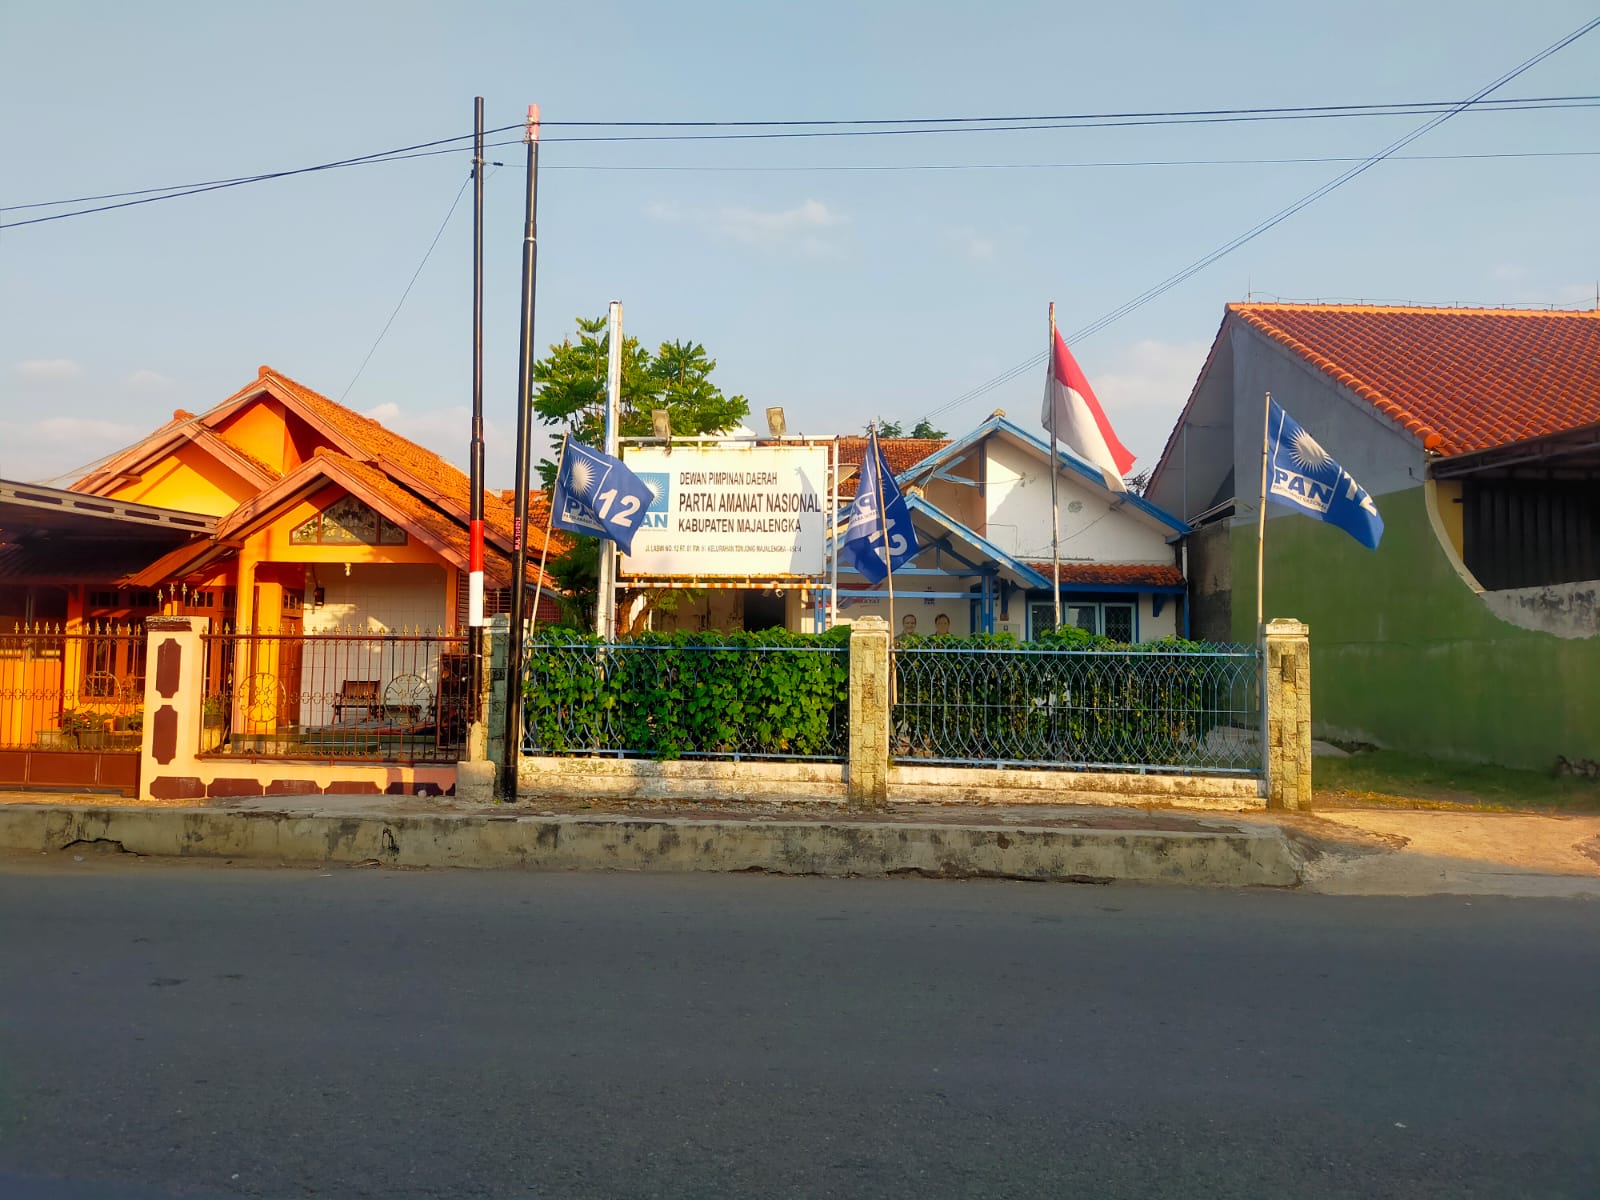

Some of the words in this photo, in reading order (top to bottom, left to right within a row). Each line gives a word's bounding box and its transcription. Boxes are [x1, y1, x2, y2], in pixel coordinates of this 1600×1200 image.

[679, 472, 707, 485] DEWAN
[708, 472, 744, 485] PIMPINAN
[745, 472, 778, 485] DAERAH
[1274, 468, 1333, 504] PAN
[598, 488, 641, 528] 12
[679, 493, 716, 513] PARTAI
[718, 493, 764, 513] AMANAT
[766, 493, 821, 513] NASIONAL
[678, 518, 734, 533] KABUPATEN
[737, 518, 802, 533] MAJALENGKA
